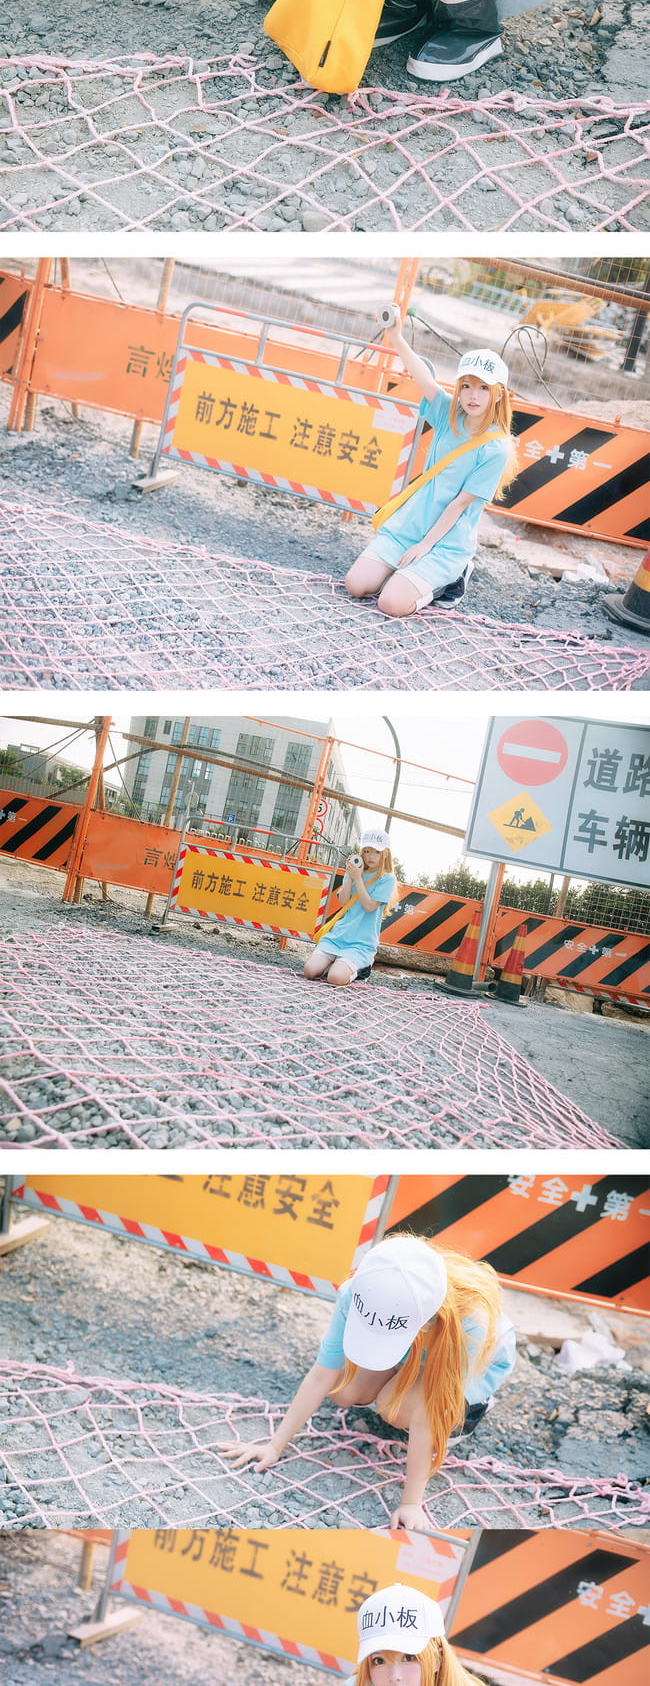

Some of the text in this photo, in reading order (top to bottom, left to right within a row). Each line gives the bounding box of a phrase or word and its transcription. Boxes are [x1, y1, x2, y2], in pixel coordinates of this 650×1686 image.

[195, 391, 382, 469] 前方施工 注意安全
[583, 747, 650, 798] 道路
[573, 809, 650, 863] 车辆
[191, 870, 247, 897] 前方施工
[252, 882, 310, 912] 注意安全
[202, 1175, 341, 1231] 注意安全
[353, 1293, 410, 1330] 血小板
[154, 1529, 269, 1580] 前方施工
[280, 1549, 378, 1613] 注意安
[362, 1606, 418, 1630] 血小板
